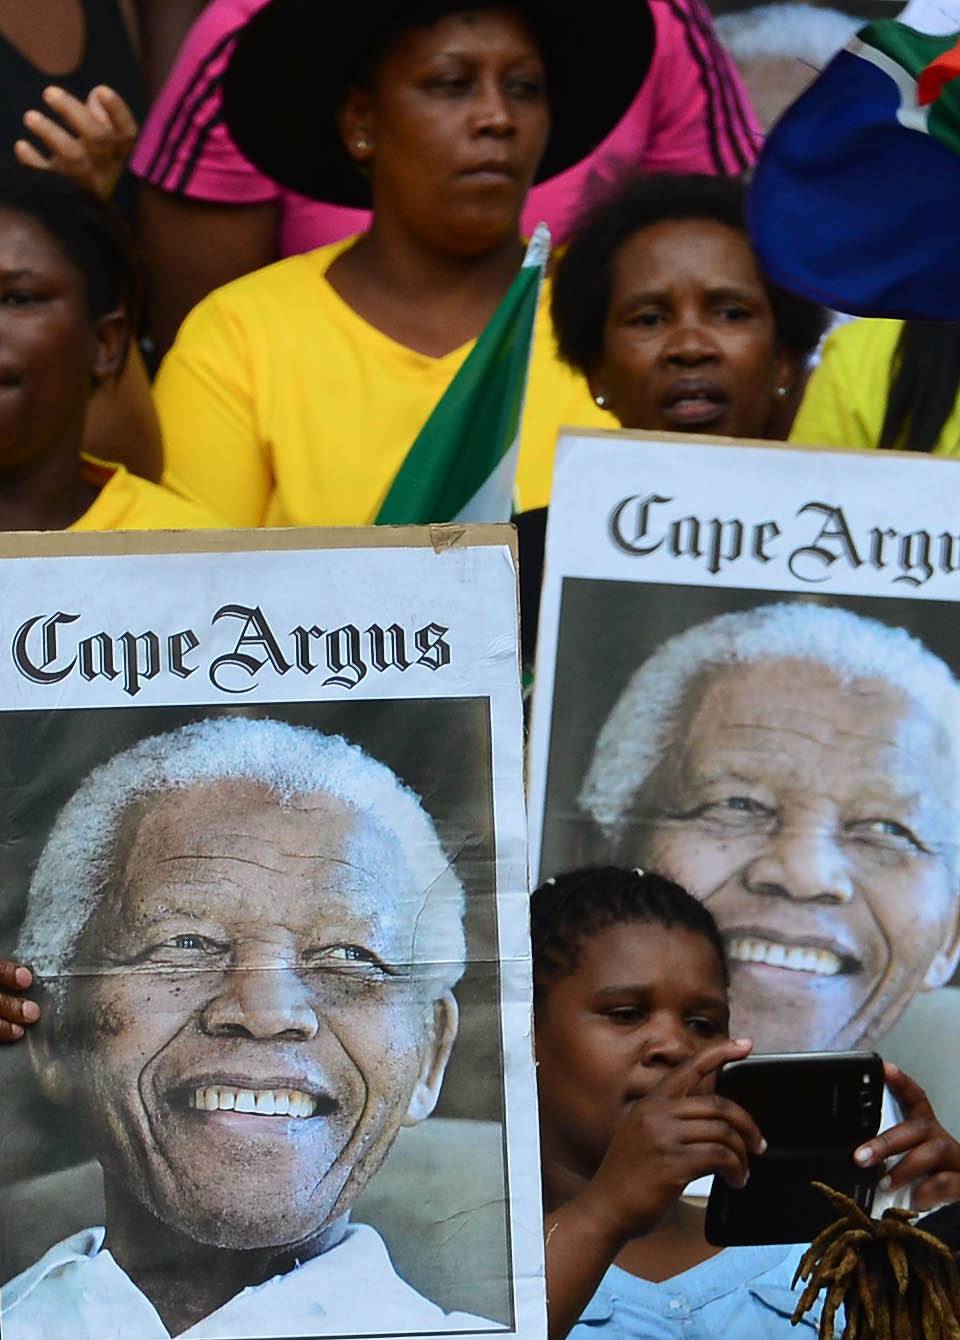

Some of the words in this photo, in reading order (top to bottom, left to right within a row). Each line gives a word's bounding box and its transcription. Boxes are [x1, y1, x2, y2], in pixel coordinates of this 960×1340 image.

[607, 493, 782, 576] Cape
[11, 610, 201, 697] Cape
[208, 603, 452, 695] Argus
